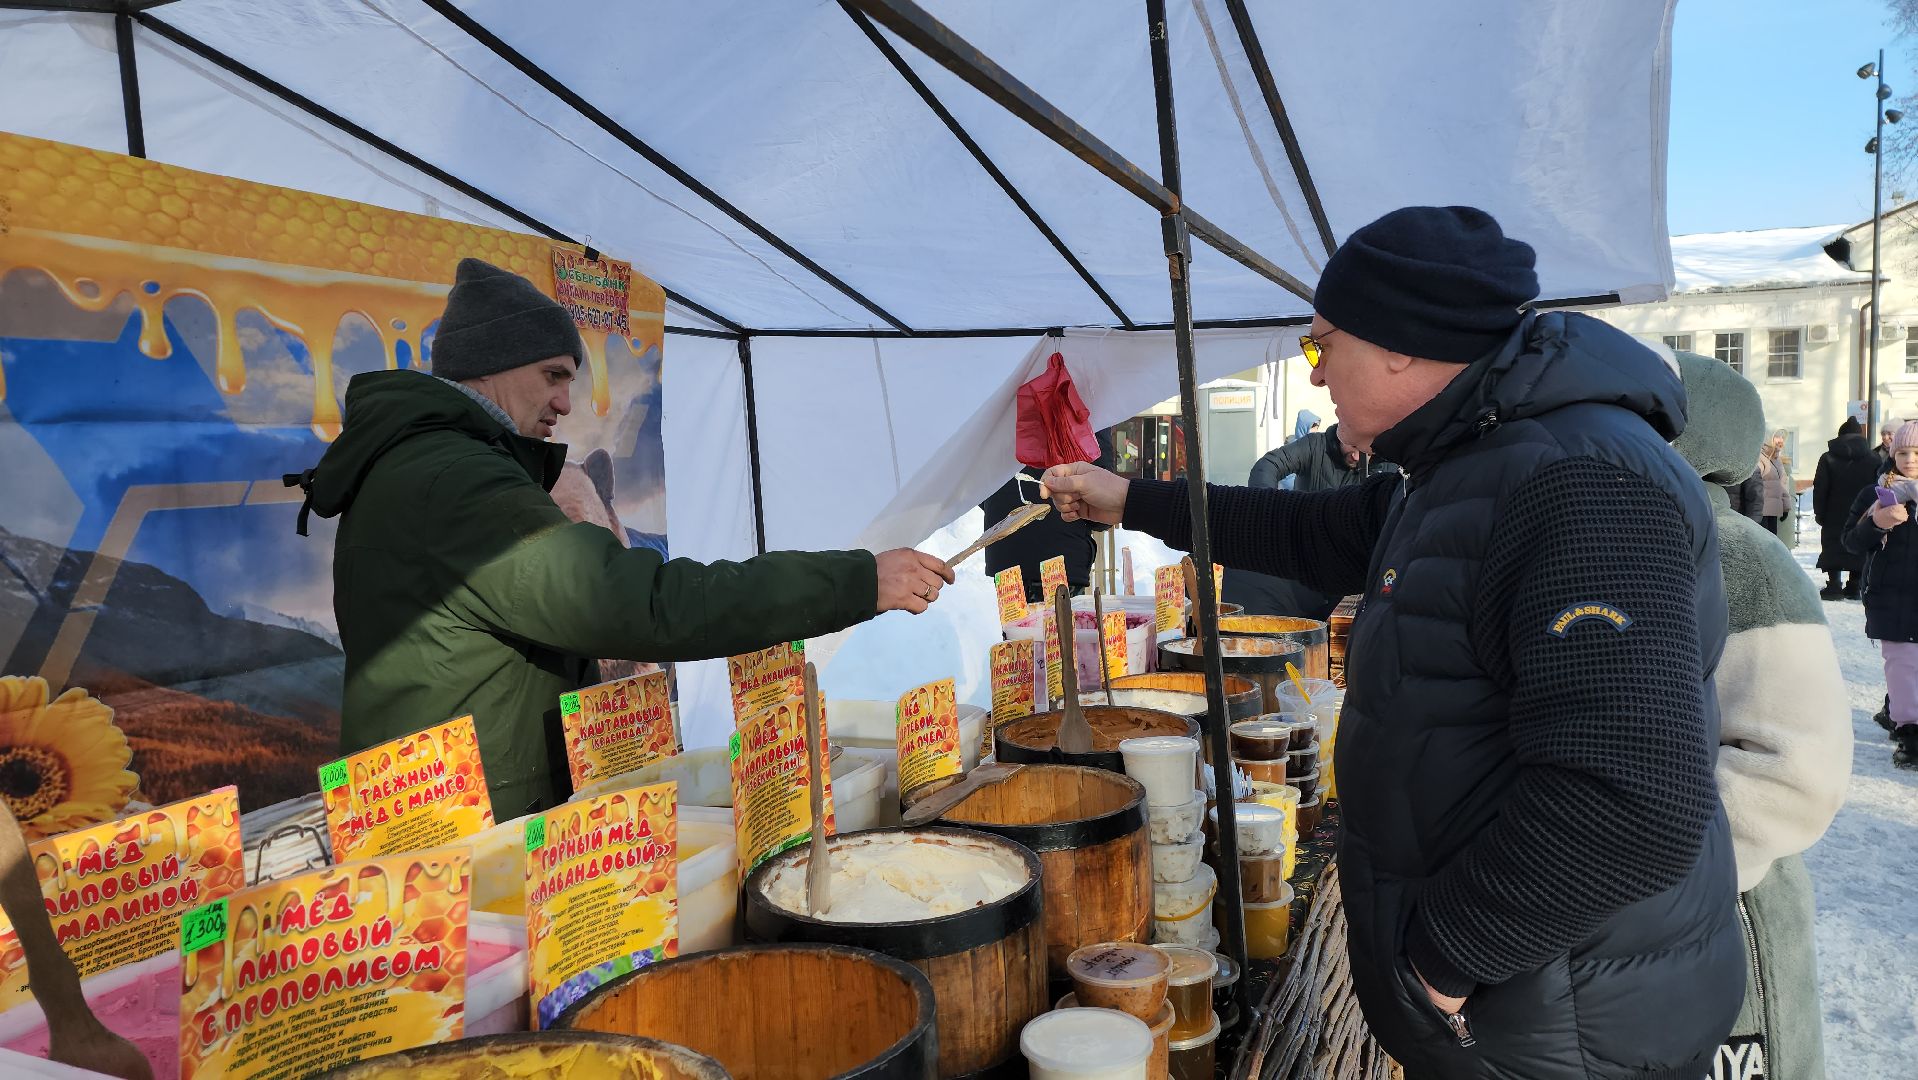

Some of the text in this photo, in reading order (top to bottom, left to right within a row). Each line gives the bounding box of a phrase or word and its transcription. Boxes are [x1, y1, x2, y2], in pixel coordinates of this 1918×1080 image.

[568, 268, 625, 291] СБЕРБАНК
[1553, 612, 1577, 634] PAUL
[1584, 605, 1627, 626] SHARK
[580, 703, 660, 739] КАШТАНОВЫЙ
[360, 758, 446, 807] ТАЁЖНЫЙ
[350, 774, 466, 836] МЁД С МАНГО
[78, 841, 145, 878] МЁД
[541, 825, 603, 872] ГОРНЫЙ
[608, 817, 652, 845] МЁД
[44, 853, 180, 917] ЛИПОВЫЙ
[57, 877, 199, 946] МАЛИНОЙ
[130, 918, 158, 933] кислоту
[280, 892, 353, 936] МЁД
[86, 962, 110, 975] любом
[238, 915, 393, 990] ЛИПОВЫЙ
[201, 945, 441, 1046] С ПРОПОЛИСОМ
[350, 988, 387, 1004] гастрите
[358, 1005, 398, 1023] средство
